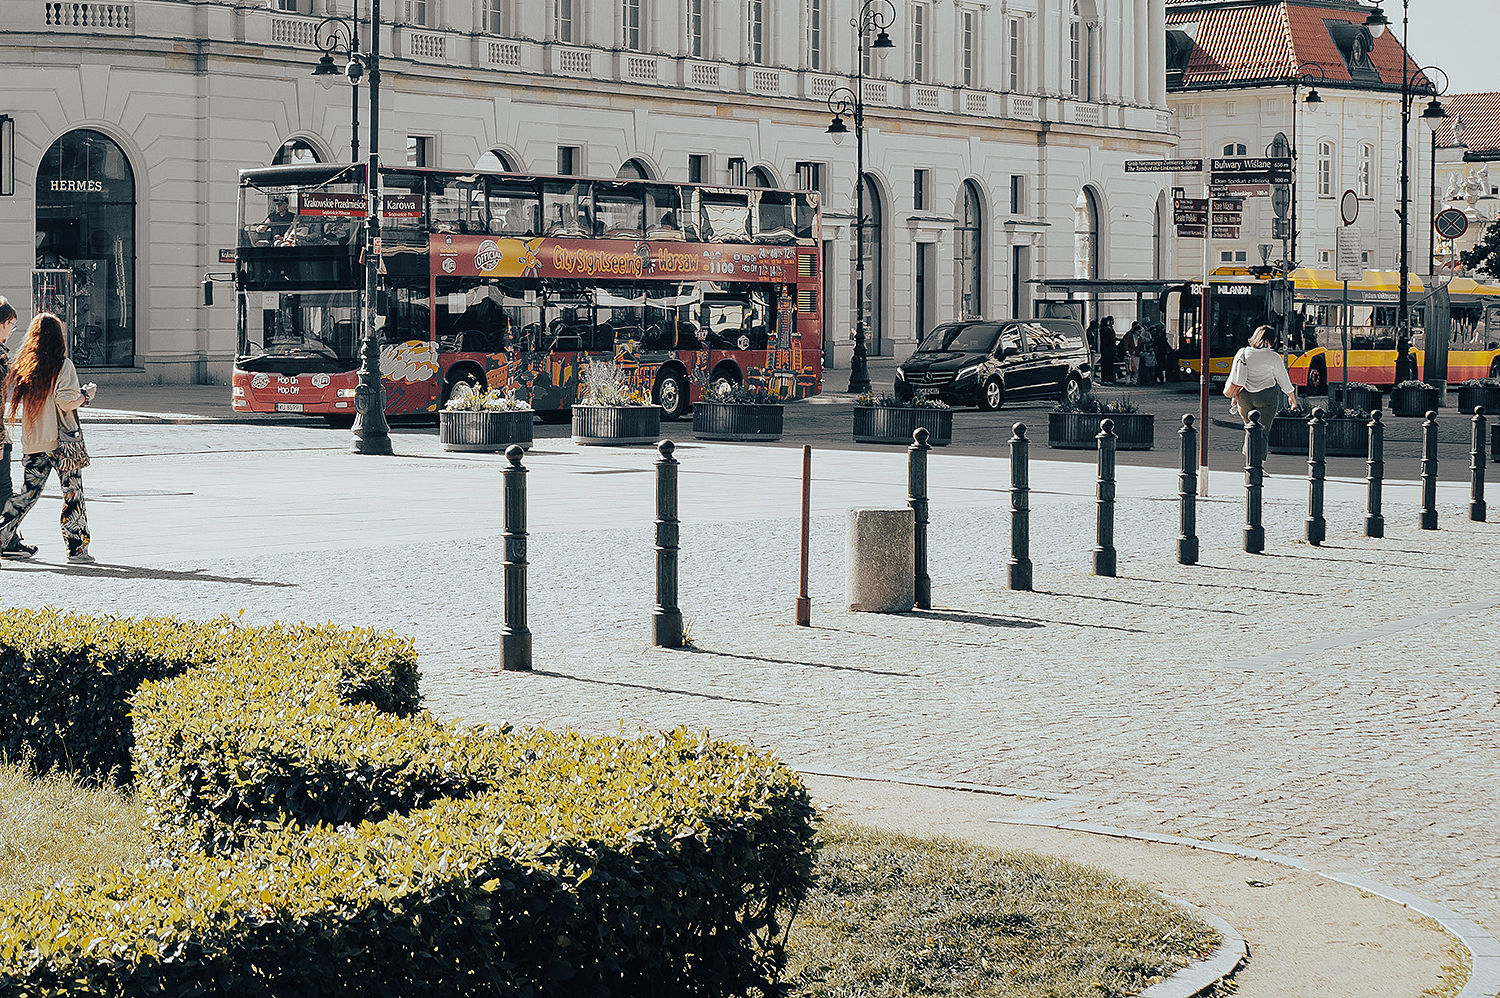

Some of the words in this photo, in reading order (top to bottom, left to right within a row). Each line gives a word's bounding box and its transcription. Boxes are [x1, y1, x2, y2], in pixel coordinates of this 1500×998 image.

[1214, 160, 1242, 170] Bulwary
[304, 198, 334, 208] Krakowskie
[334, 198, 366, 210] Przedmieście
[387, 200, 416, 210] Karowa
[476, 251, 503, 266] OFFICIAL
[658, 247, 699, 272] Warsaw
[277, 376, 289, 385] Hop
[290, 376, 299, 384] On
[277, 386, 289, 395] Hop
[290, 386, 300, 395] Off
